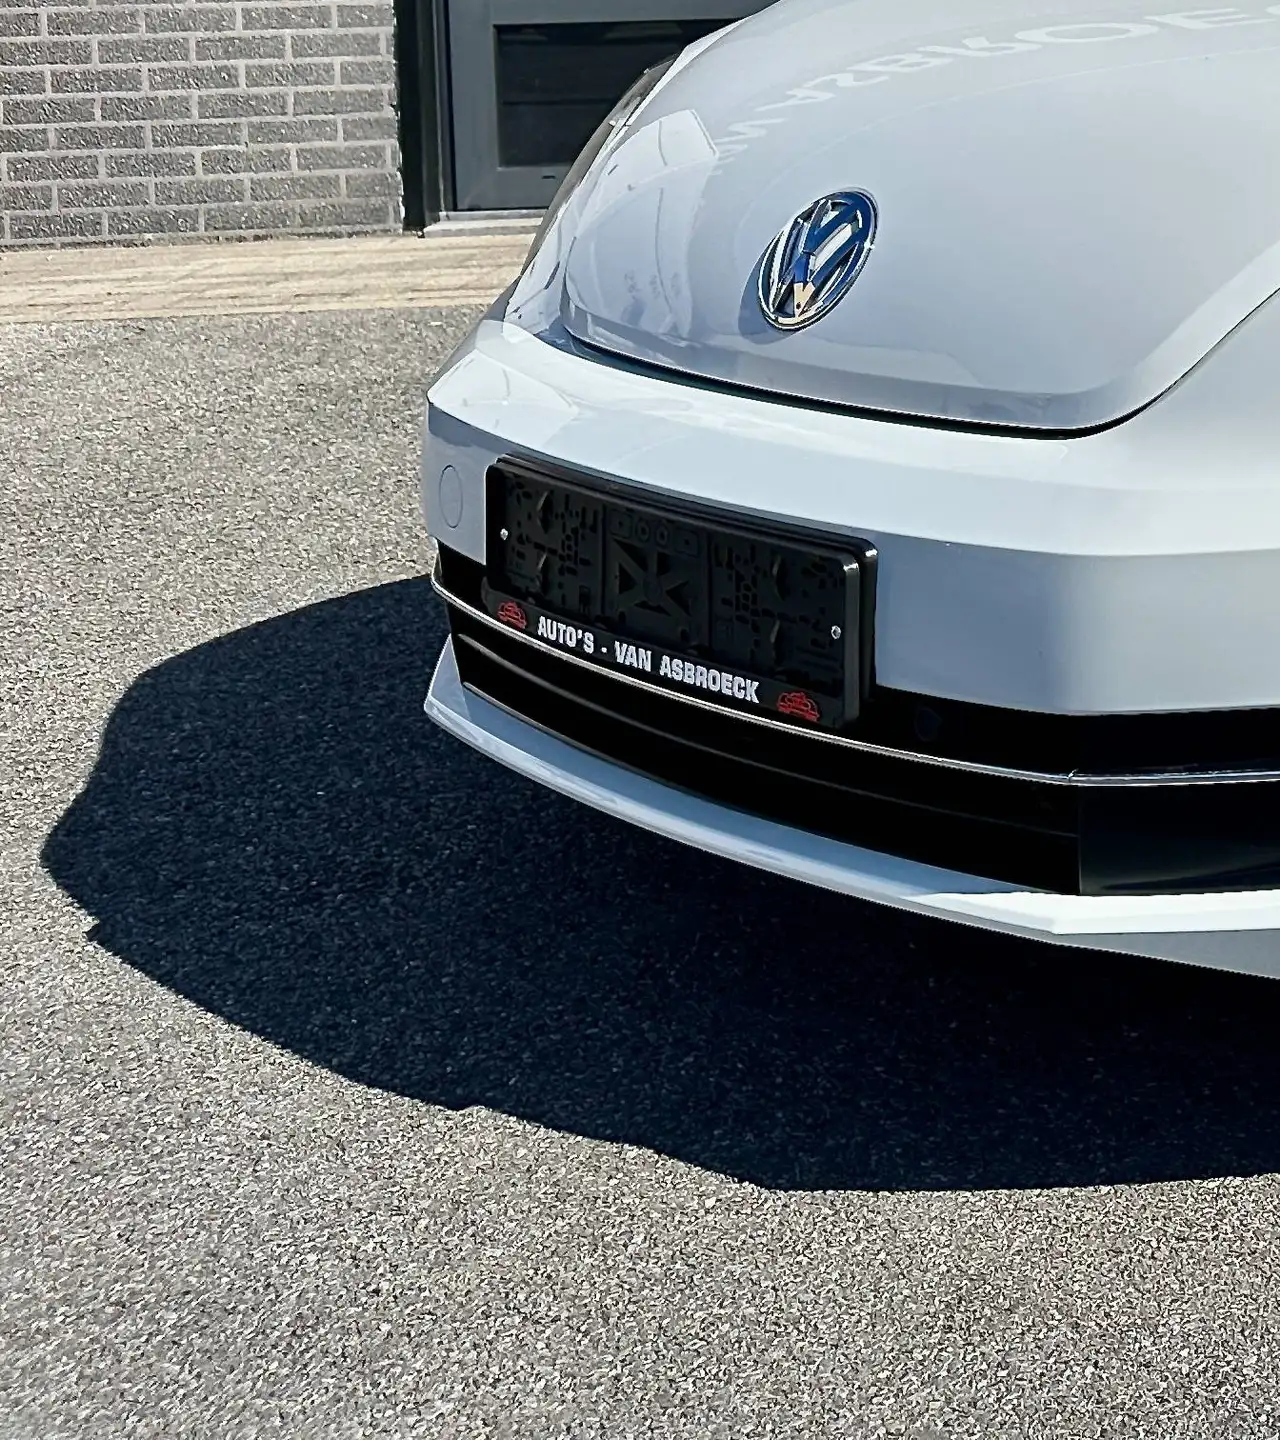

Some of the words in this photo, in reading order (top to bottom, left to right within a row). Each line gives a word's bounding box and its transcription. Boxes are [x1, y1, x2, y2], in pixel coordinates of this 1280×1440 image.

[537, 614, 595, 655] AUTO'S
[613, 640, 653, 673] VAN
[659, 653, 760, 704] ASBROECK
